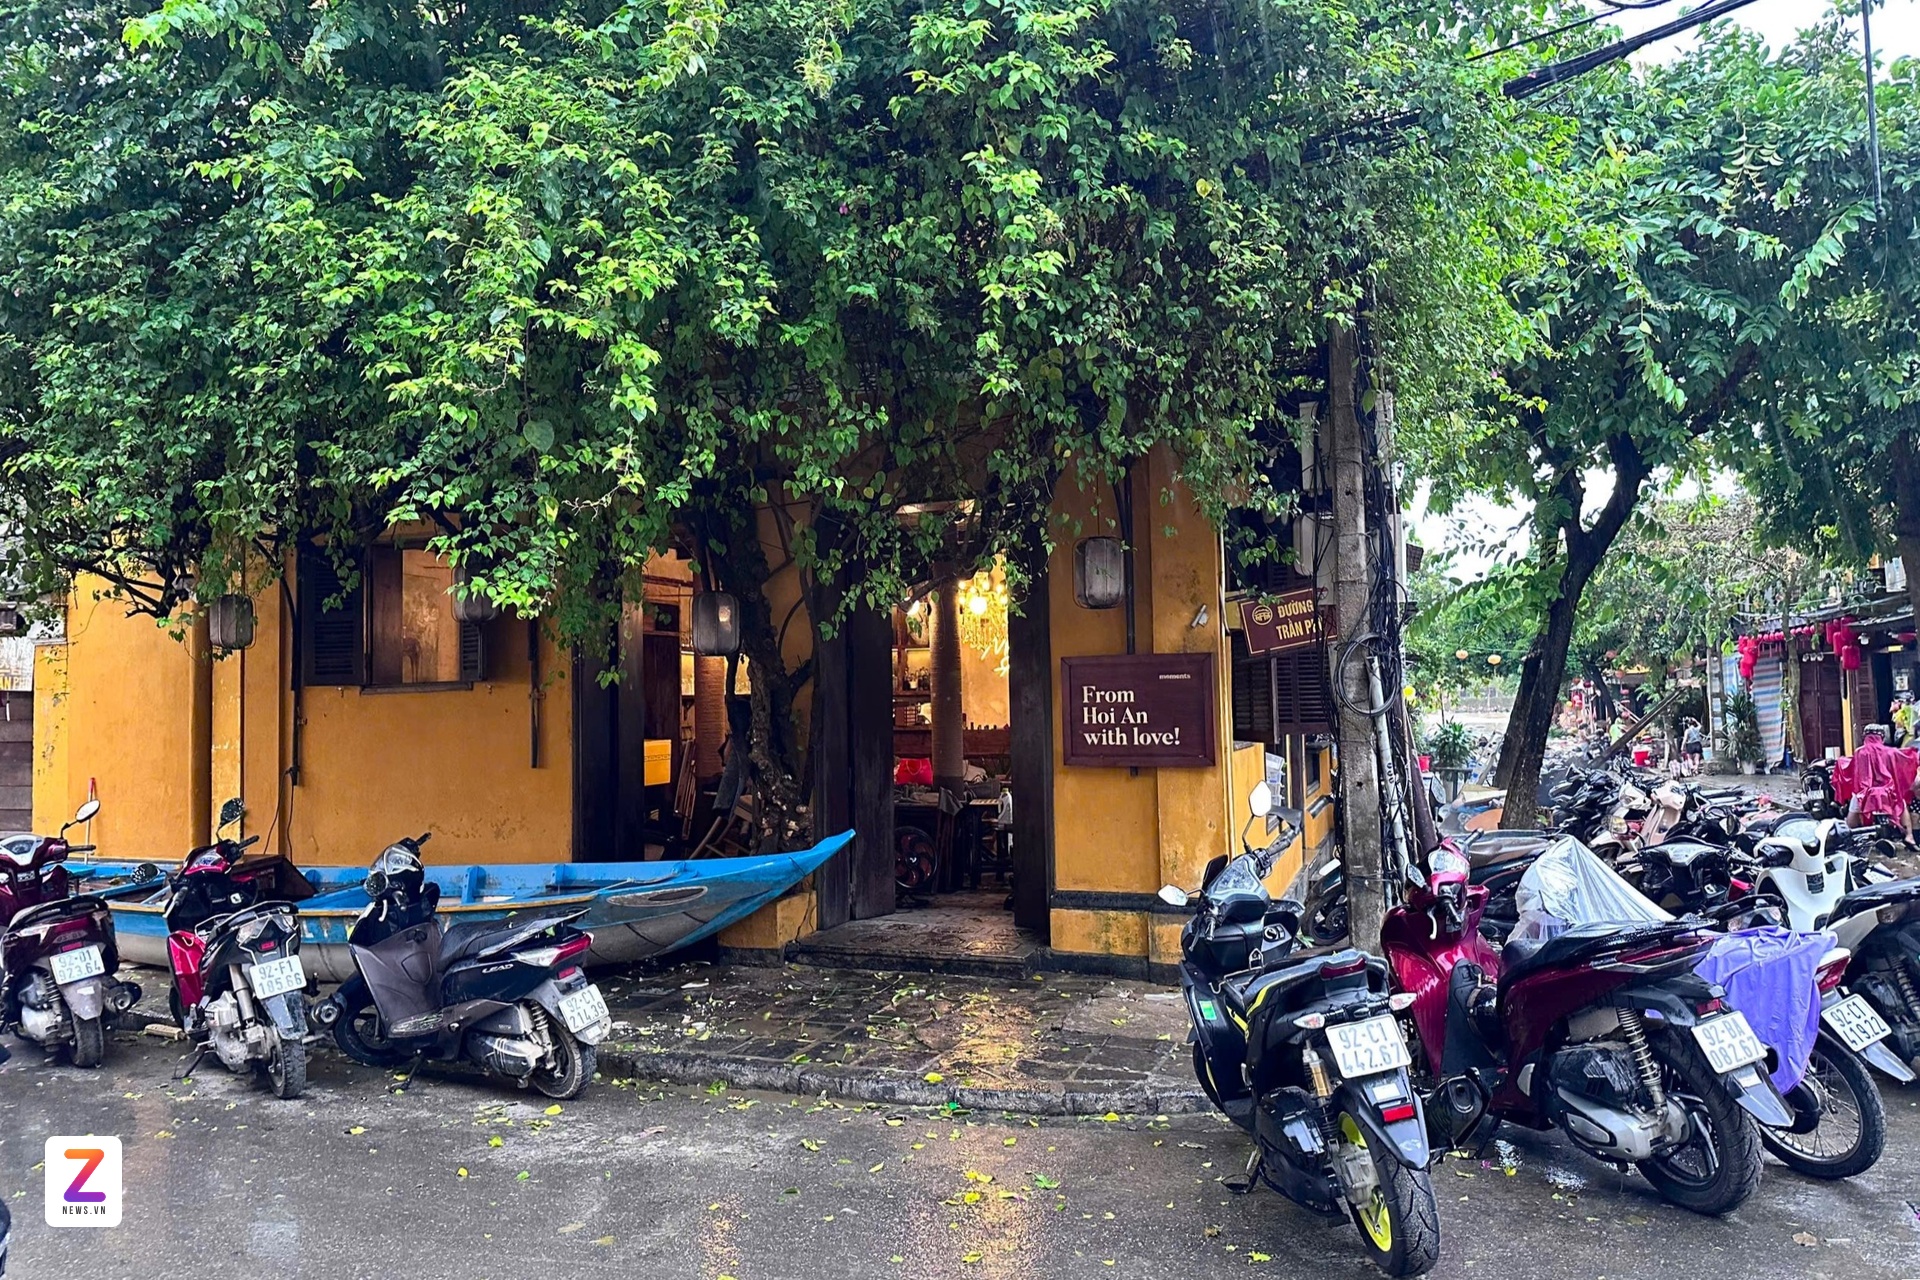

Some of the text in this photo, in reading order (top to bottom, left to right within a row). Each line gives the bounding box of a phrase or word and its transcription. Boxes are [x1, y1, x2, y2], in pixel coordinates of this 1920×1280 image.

[1277, 599, 1314, 618] ĐƯỜNG
[1276, 618, 1303, 640] TRẦN
[1082, 685, 1135, 703] From
[1083, 706, 1149, 724] Hoi An
[1083, 727, 1181, 746] with love!
[258, 959, 294, 980] 92-F1
[481, 963, 514, 974] LEAD
[566, 990, 596, 1013] 92-C1
[569, 1001, 606, 1028] 214.39
[1830, 1001, 1866, 1027] 92-C1
[1339, 1022, 1387, 1049] 92-C1
[1702, 1017, 1745, 1046] 92-BA
[1842, 1016, 1886, 1046] 419.22
[1709, 1035, 1759, 1069] 082.67
